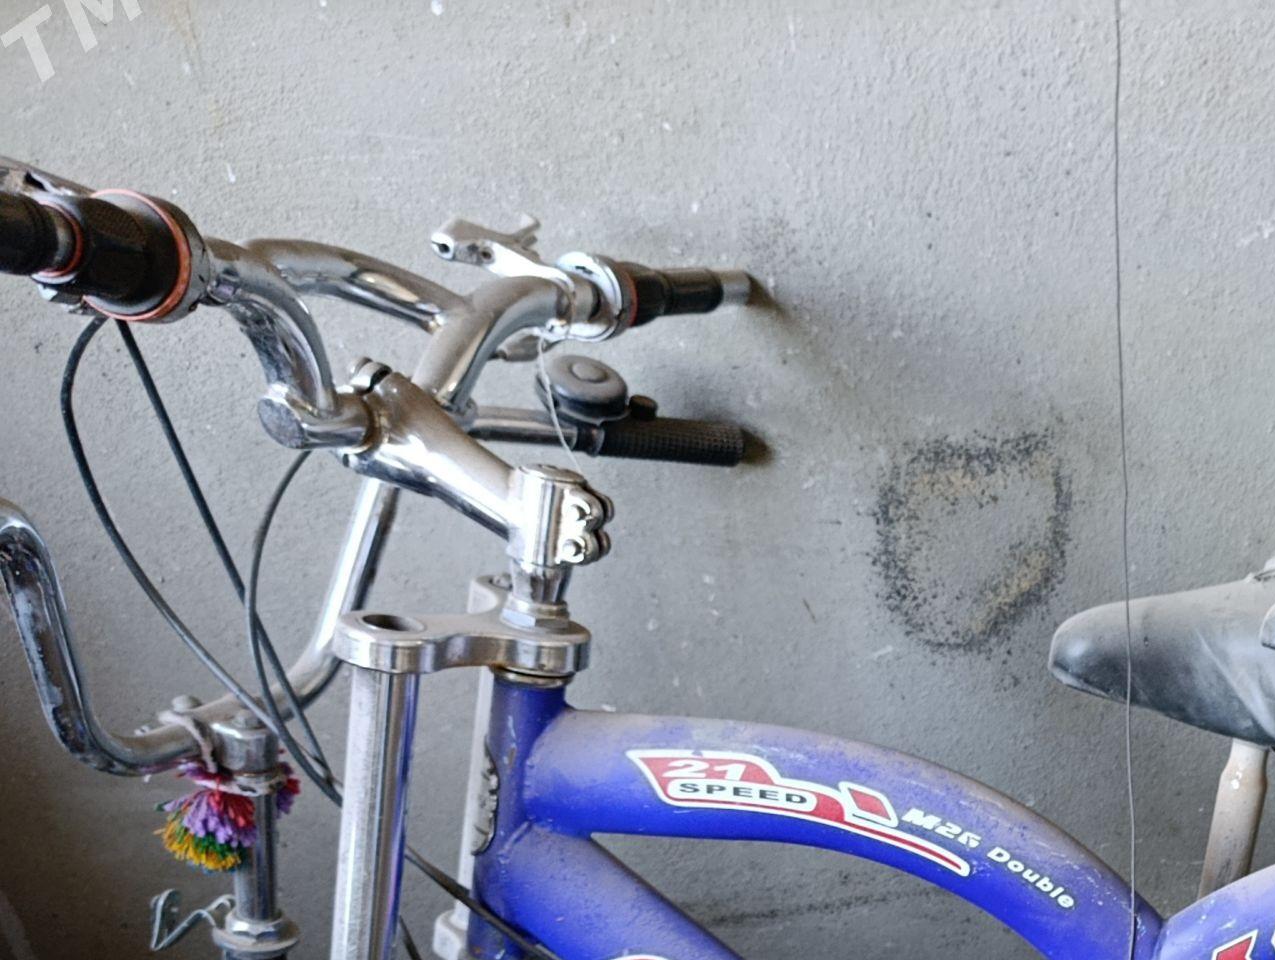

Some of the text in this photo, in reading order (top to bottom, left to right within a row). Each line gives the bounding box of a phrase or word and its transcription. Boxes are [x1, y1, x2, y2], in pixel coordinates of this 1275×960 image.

[662, 760, 747, 781] 21
[679, 783, 808, 805] SPEED
[987, 847, 1075, 909] Double
